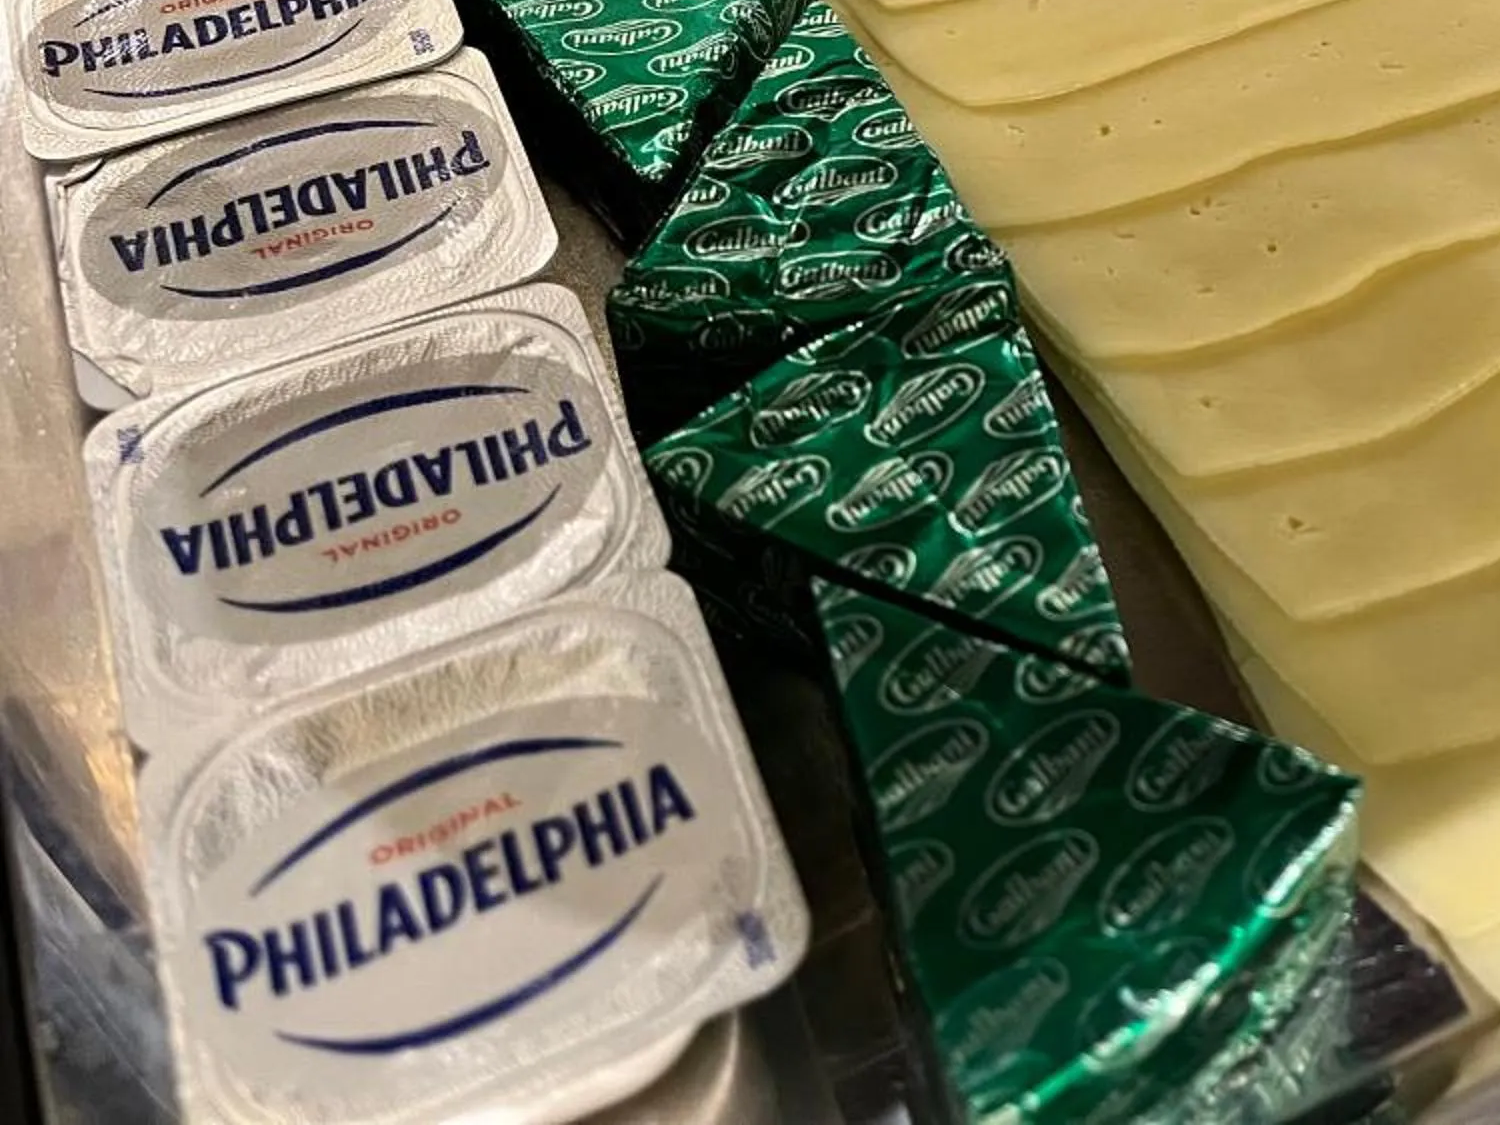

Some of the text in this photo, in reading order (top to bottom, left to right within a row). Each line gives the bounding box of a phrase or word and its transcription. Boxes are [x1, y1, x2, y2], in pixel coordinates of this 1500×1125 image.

[574, 25, 673, 47] Galbani
[111, 130, 491, 273] PHILADELPHIA
[250, 218, 375, 261] ORIGINAL
[876, 372, 976, 441] Galbani
[161, 399, 593, 575] PHILADELPHIA
[840, 459, 943, 526] Galbani
[963, 455, 1062, 527] Galbani
[321, 508, 463, 563] ORIGINAL
[369, 790, 522, 867] ORIGINAL
[205, 764, 695, 1010] PHILADELPHIA
